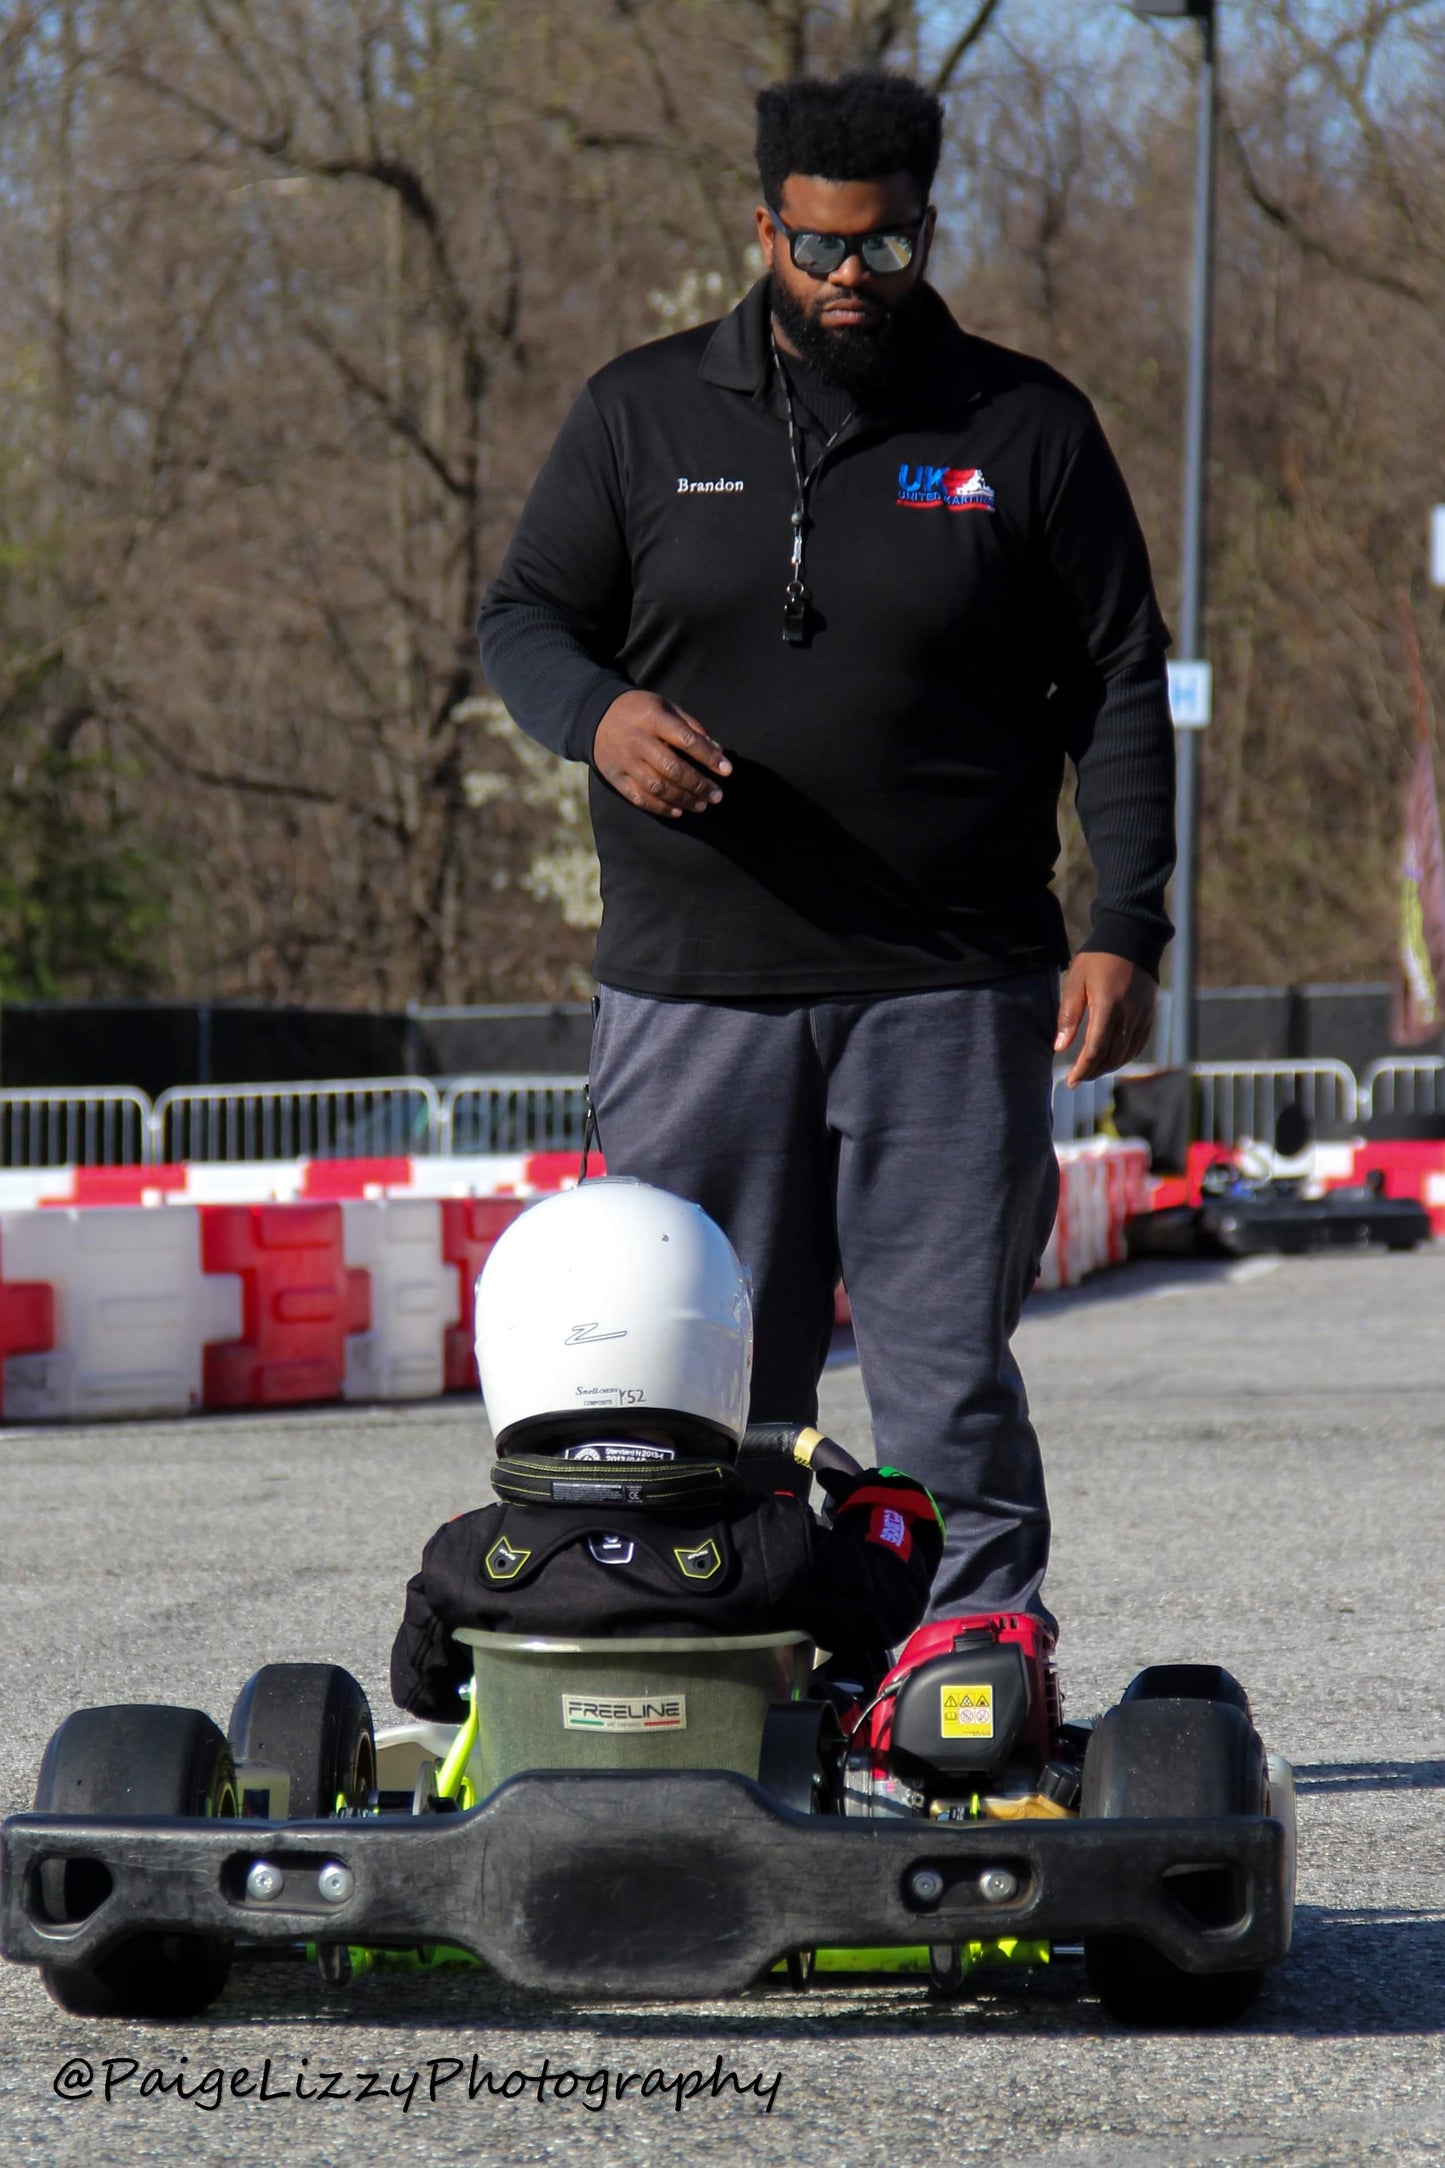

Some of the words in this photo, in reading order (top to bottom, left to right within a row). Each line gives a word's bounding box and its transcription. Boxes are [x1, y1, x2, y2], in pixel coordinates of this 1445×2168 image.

[676, 477, 744, 494] Brandon
[898, 463, 951, 493] UK
[898, 491, 941, 502] UNITED
[568, 1702, 680, 1719] FREELINE
